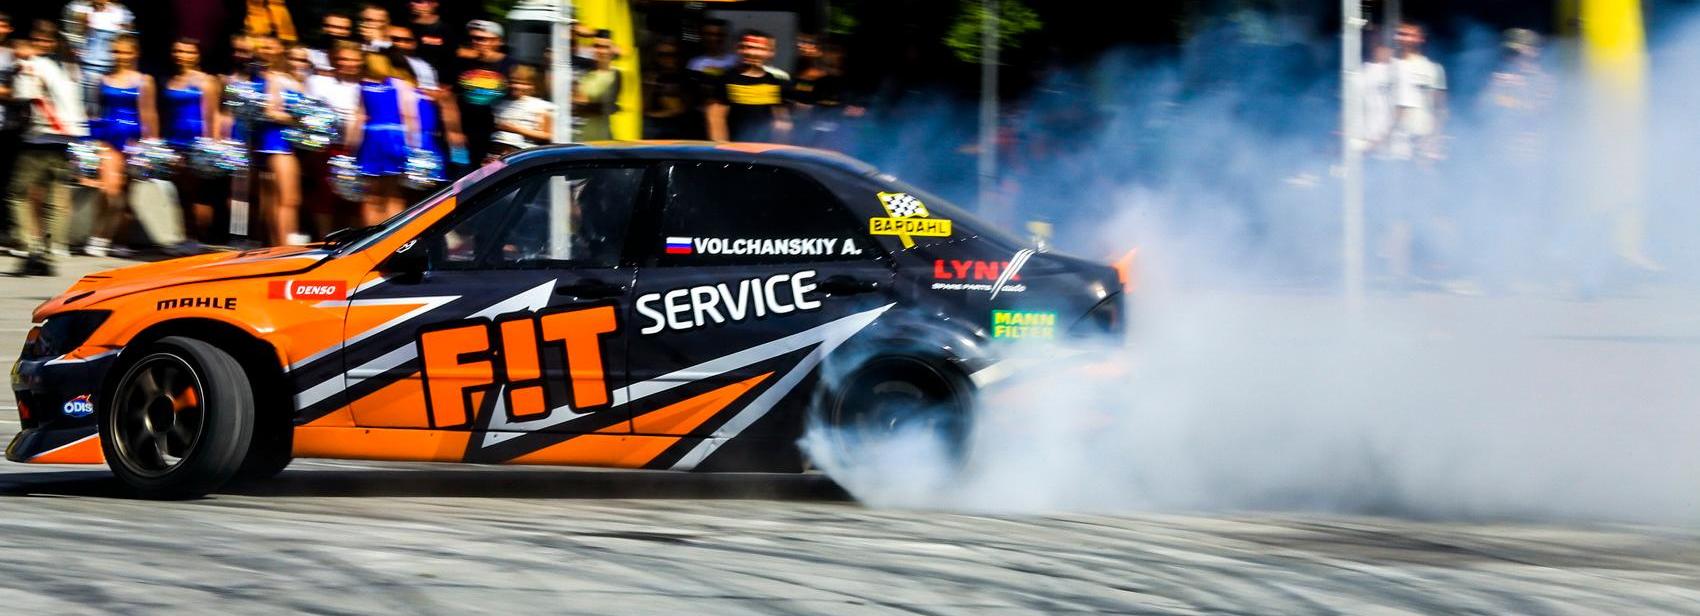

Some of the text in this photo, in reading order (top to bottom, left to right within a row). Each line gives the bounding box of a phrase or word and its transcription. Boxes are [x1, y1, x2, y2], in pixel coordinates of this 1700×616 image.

[873, 219, 946, 234] BARDAHL
[694, 238, 863, 255] VOLCHANSKIY A.
[296, 285, 336, 295] DENSO
[157, 297, 237, 311] MAHLE
[636, 270, 821, 335] SERVICE
[995, 312, 1055, 325] MANN
[995, 325, 1054, 338] FILTER
[421, 305, 617, 427] F!T
